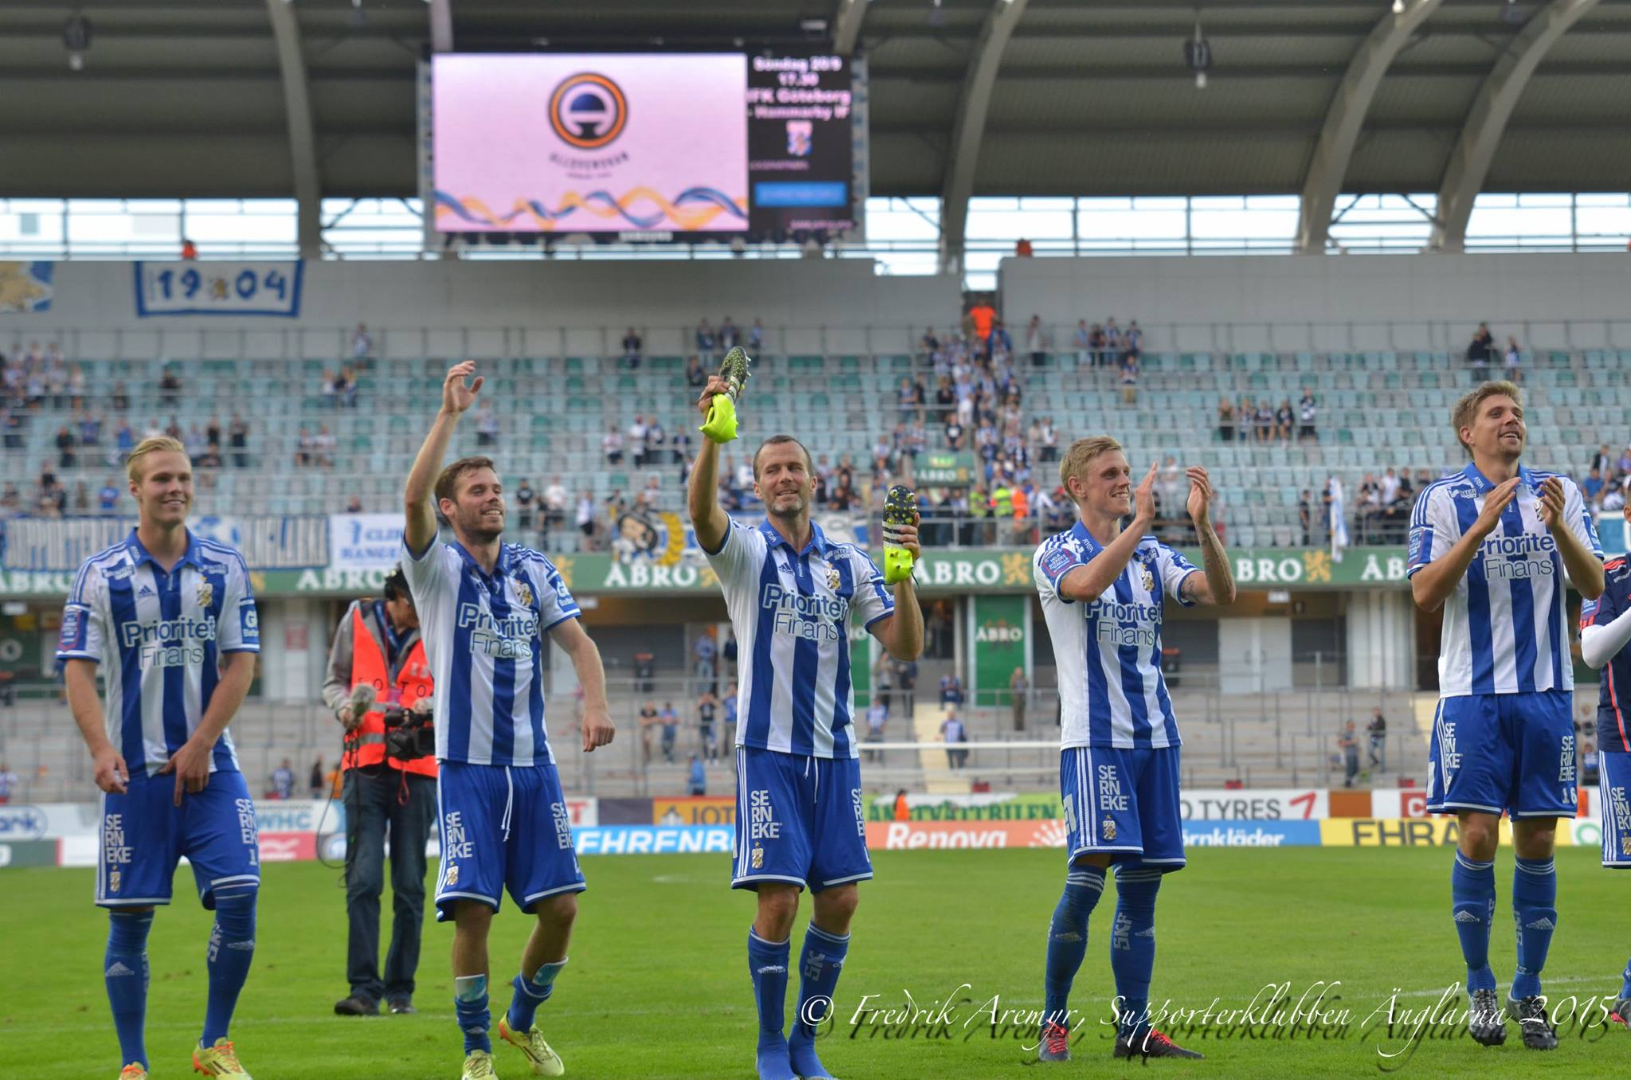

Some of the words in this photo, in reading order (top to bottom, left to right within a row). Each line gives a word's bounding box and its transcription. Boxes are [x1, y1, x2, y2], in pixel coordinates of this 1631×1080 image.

[776, 87, 851, 106] Göteborg
[157, 268, 200, 300] 19
[235, 269, 287, 301] 04
[1475, 532, 1556, 558] riorite
[1236, 557, 1302, 582] BRO
[1361, 553, 1406, 581] ÅB
[1484, 556, 1555, 580] Finans
[762, 583, 850, 621] Prioritet
[1084, 596, 1162, 625] Prioritet
[122, 616, 216, 648] Prioritet
[774, 612, 840, 641] Finans
[1097, 620, 1156, 647] Finans
[470, 630, 533, 660] Finans
[139, 645, 205, 670] Finans
[1561, 735, 1574, 752] SE
[1097, 764, 1117, 781] SE
[750, 789, 769, 807] SE
[1099, 780, 1121, 796] RN
[1611, 786, 1626, 802] SE
[1100, 795, 1129, 811] EKE
[1198, 799, 1282, 821] TYRES
[105, 814, 123, 831] SE
[445, 811, 461, 830] SE
[751, 806, 772, 823] RN
[105, 830, 125, 848] RN
[447, 826, 466, 845] RN
[751, 822, 780, 839] EKE
[886, 822, 1007, 850] Renova
[575, 829, 737, 855] EHRENB
[106, 847, 132, 863] EKE
